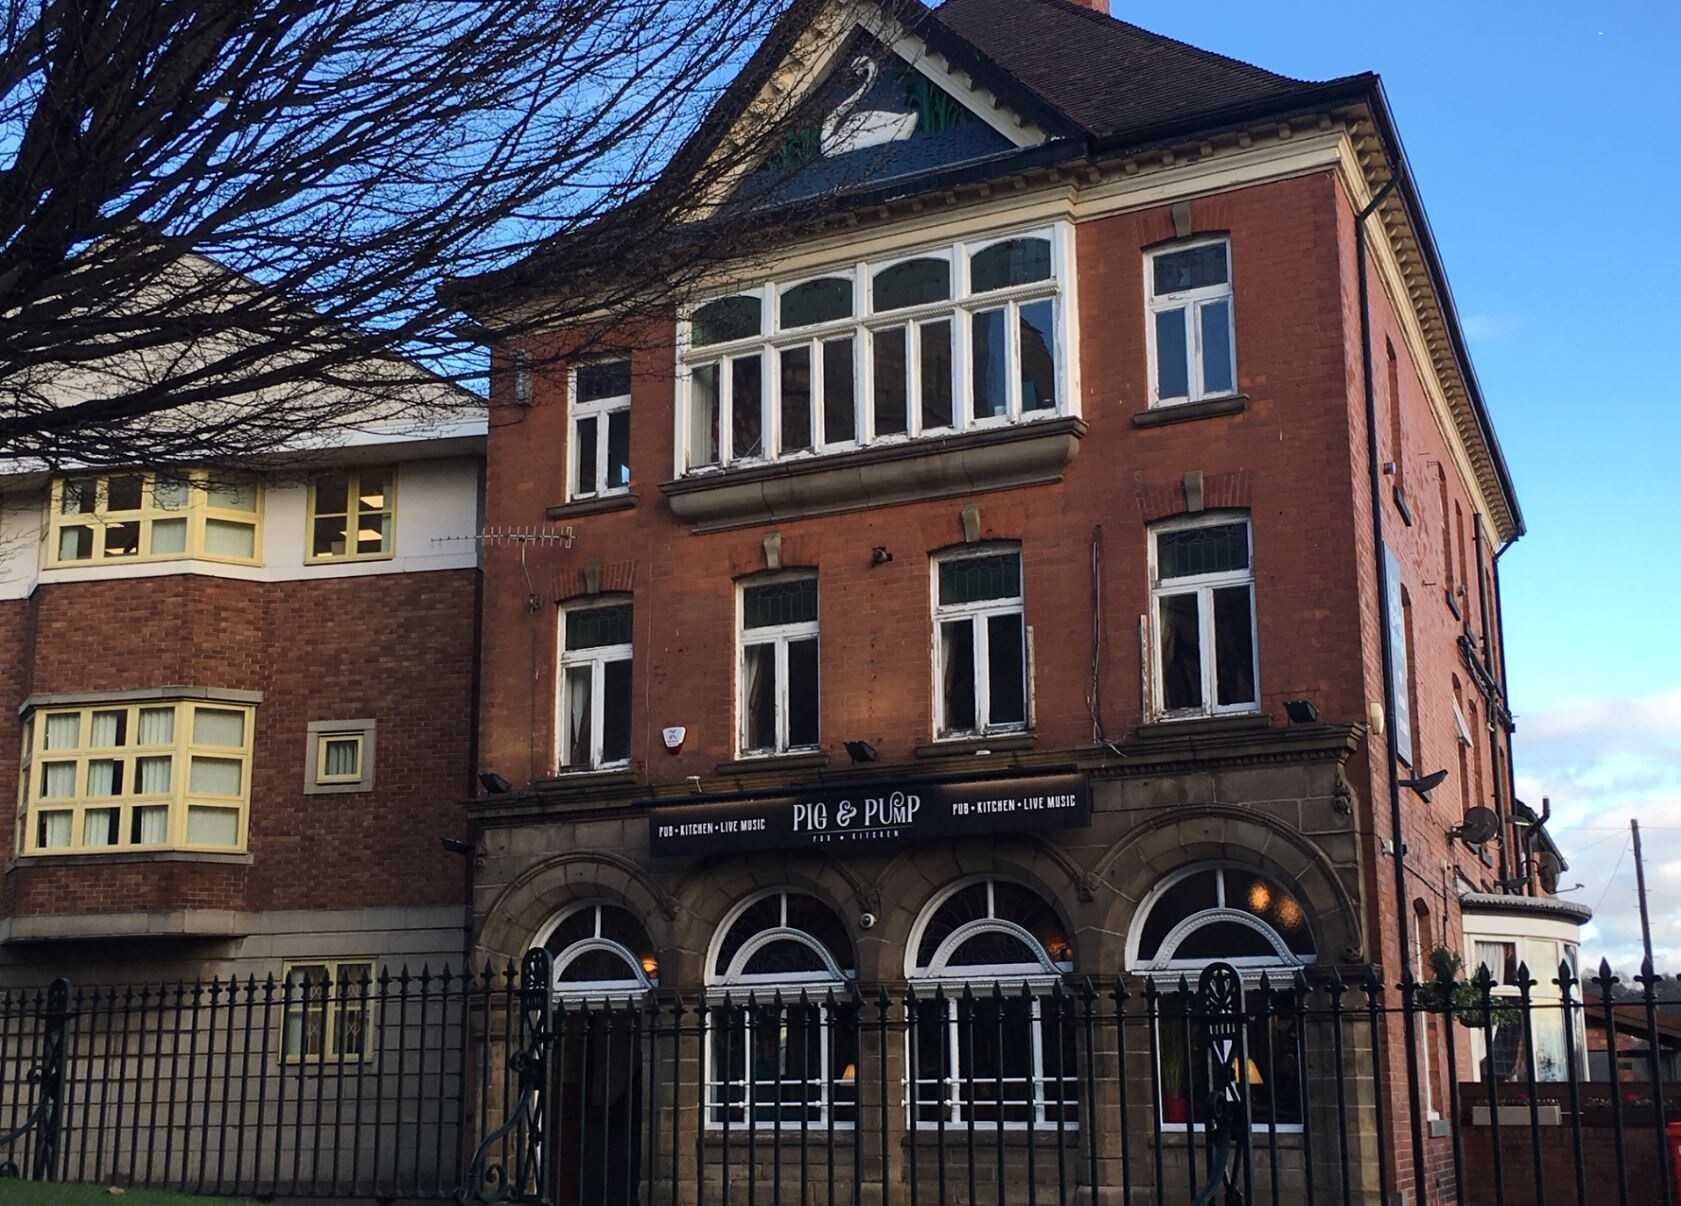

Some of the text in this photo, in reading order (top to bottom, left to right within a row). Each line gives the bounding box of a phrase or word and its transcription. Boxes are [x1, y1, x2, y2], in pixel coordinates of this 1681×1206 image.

[793, 791, 921, 831] PIG & PUMP
[952, 794, 1076, 815] PUB KITCHEN LIVE MUSIC
[659, 818, 766, 837] PUB KITCHEN LIVE MUSIC
